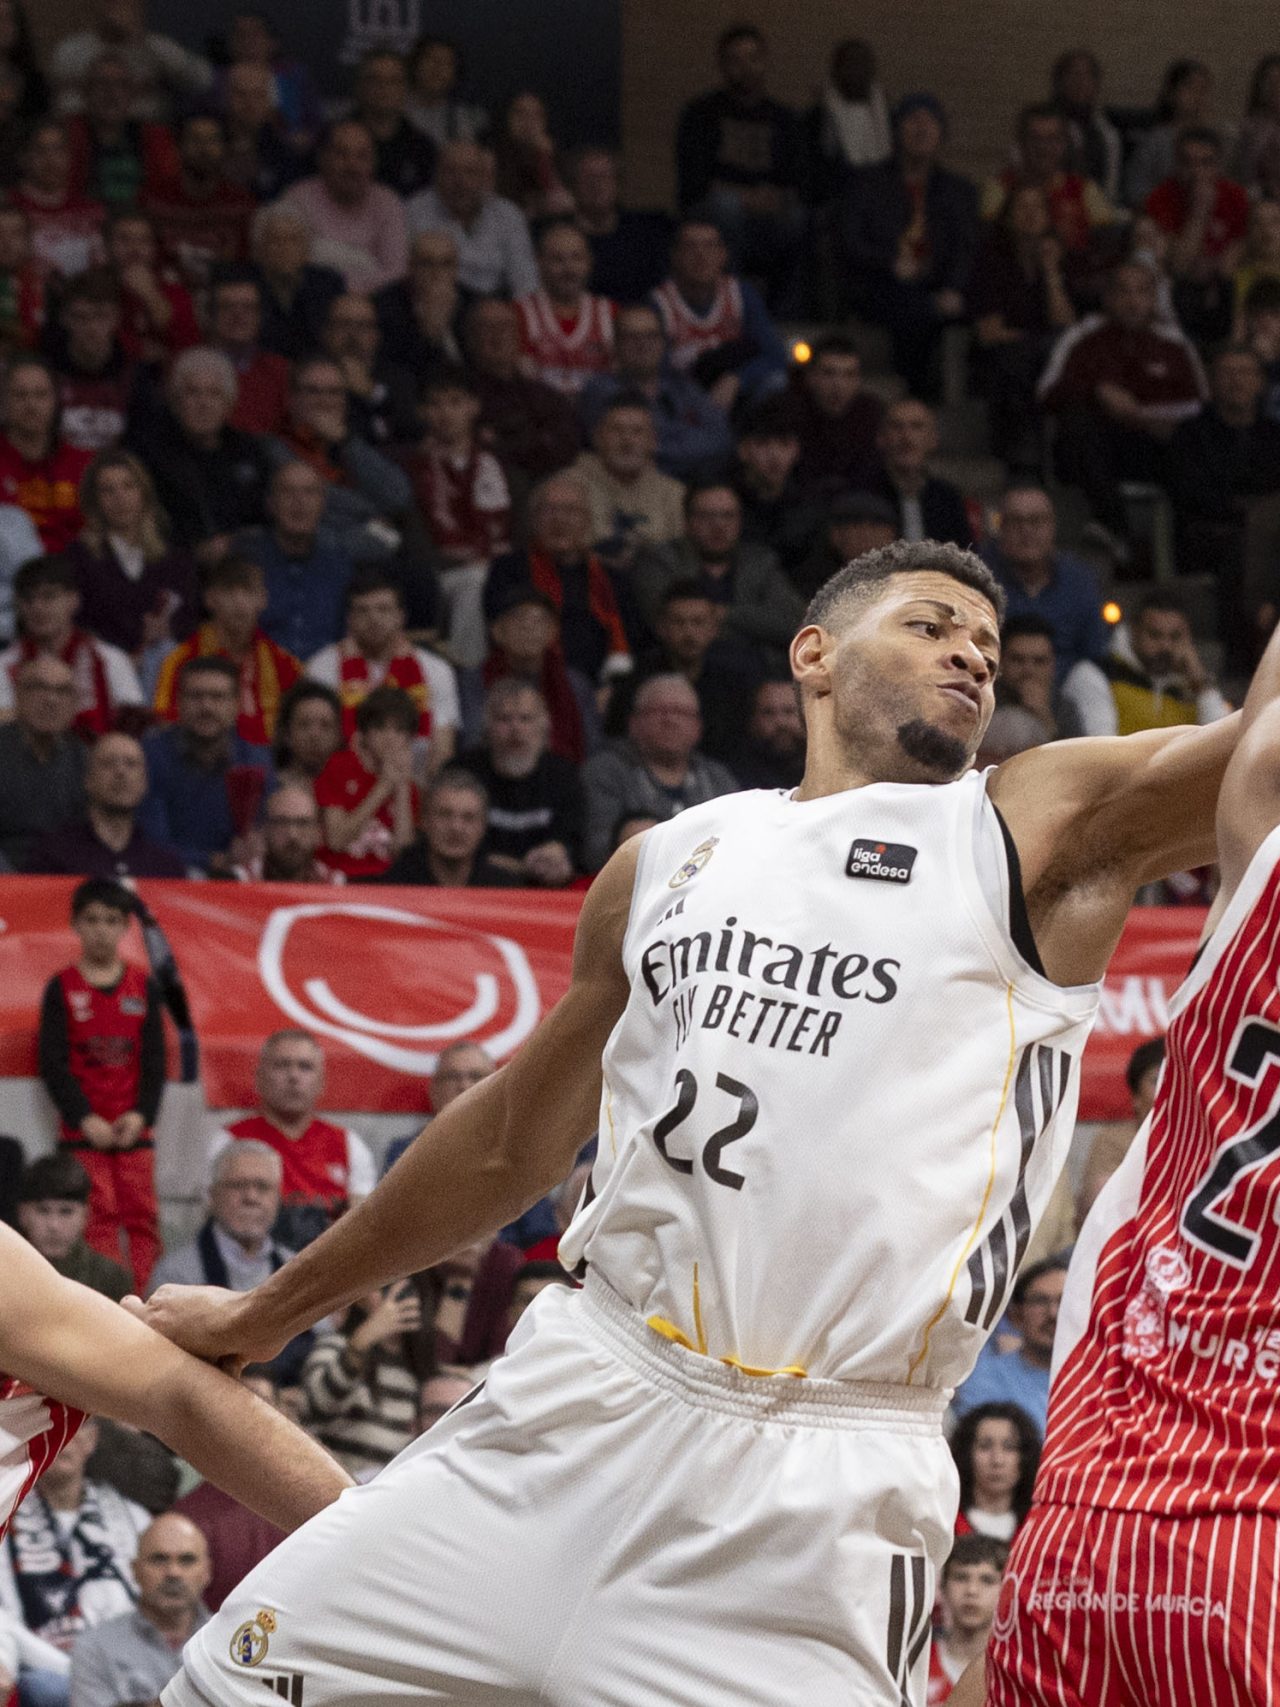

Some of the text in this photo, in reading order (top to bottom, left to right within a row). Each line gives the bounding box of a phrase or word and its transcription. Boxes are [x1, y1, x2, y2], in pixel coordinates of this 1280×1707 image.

[850, 861, 909, 880] endesa
[853, 847, 881, 863] liga
[641, 916, 901, 1007] Emirates
[701, 984, 843, 1058] BETTER
[652, 1068, 760, 1192] 22
[1112, 1592, 1140, 1613] DE
[1145, 1593, 1230, 1620] MURCIA
